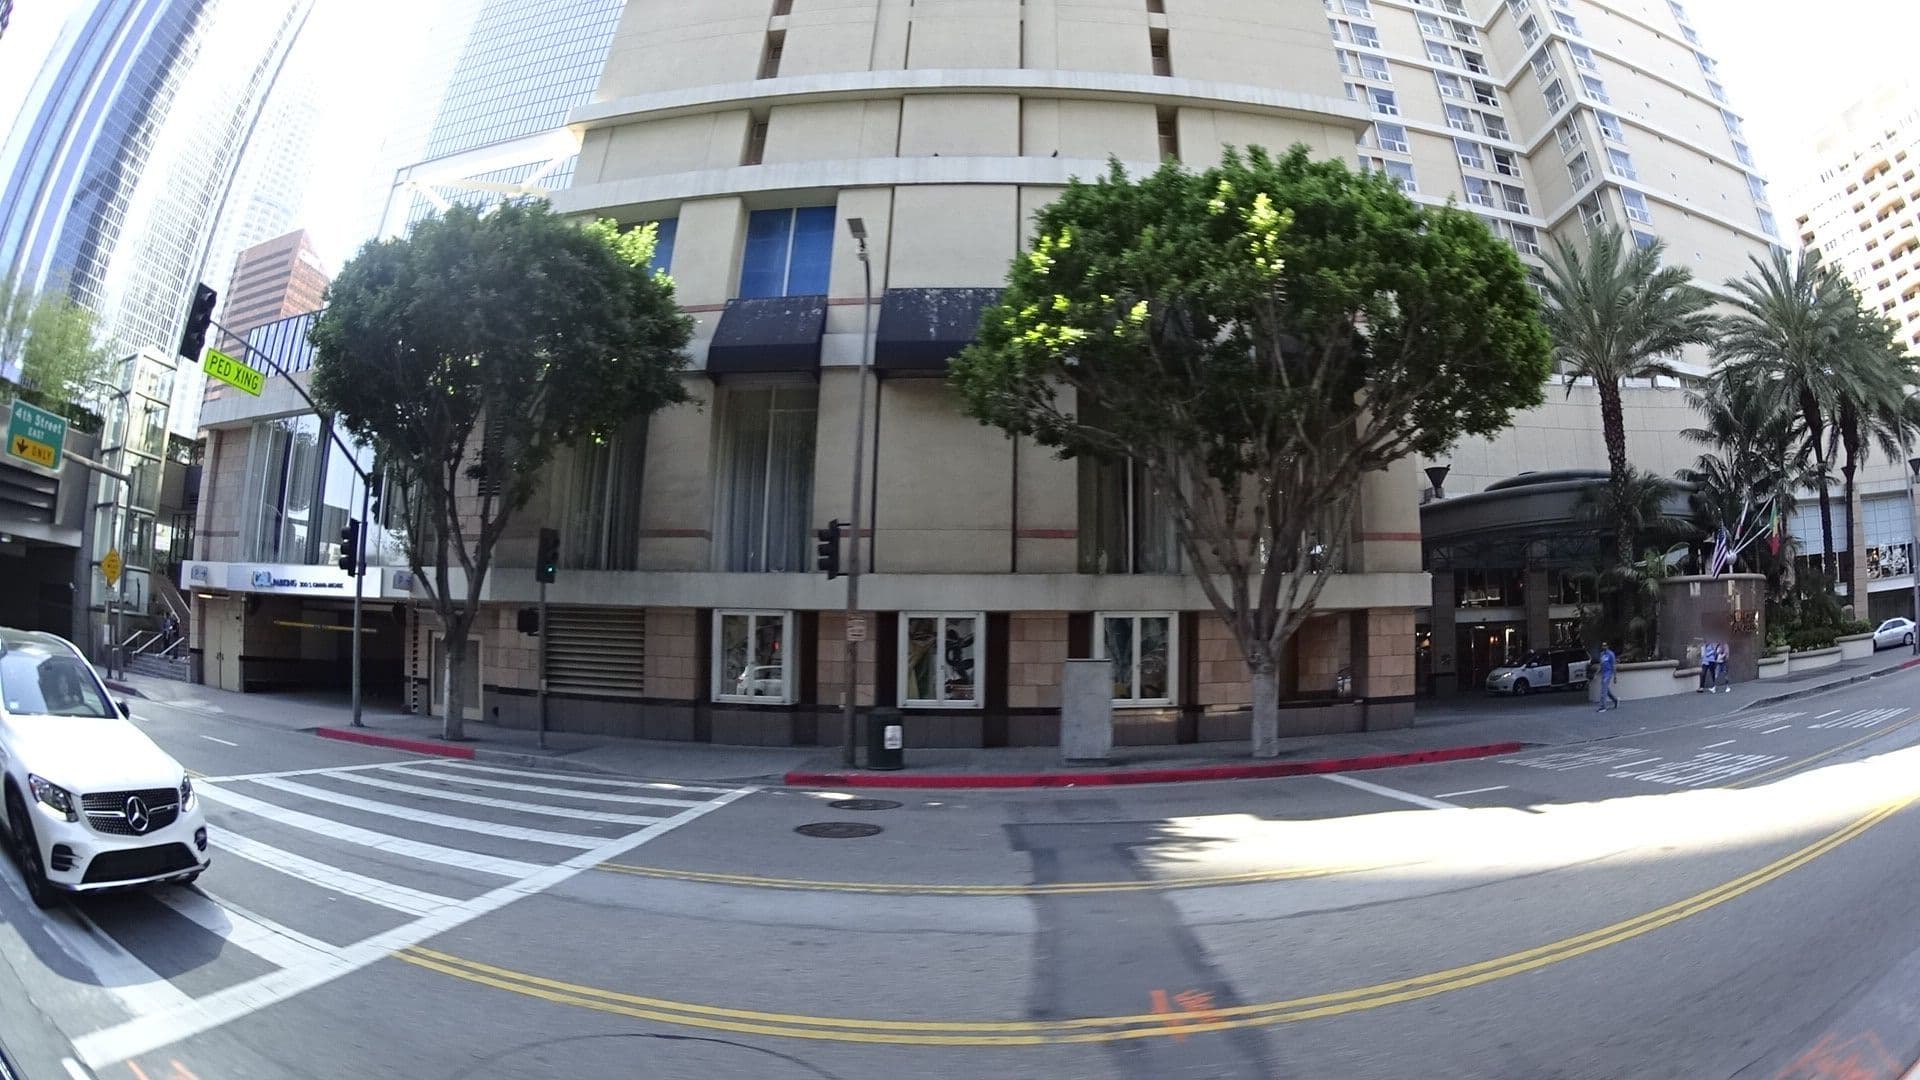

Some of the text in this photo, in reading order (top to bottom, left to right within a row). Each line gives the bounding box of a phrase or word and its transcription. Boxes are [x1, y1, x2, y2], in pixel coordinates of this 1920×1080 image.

[209, 355, 259, 390] PED XING
[15, 407, 62, 435] 4th Street
[27, 426, 45, 440] EAST
[32, 445, 54, 460] ONLY
